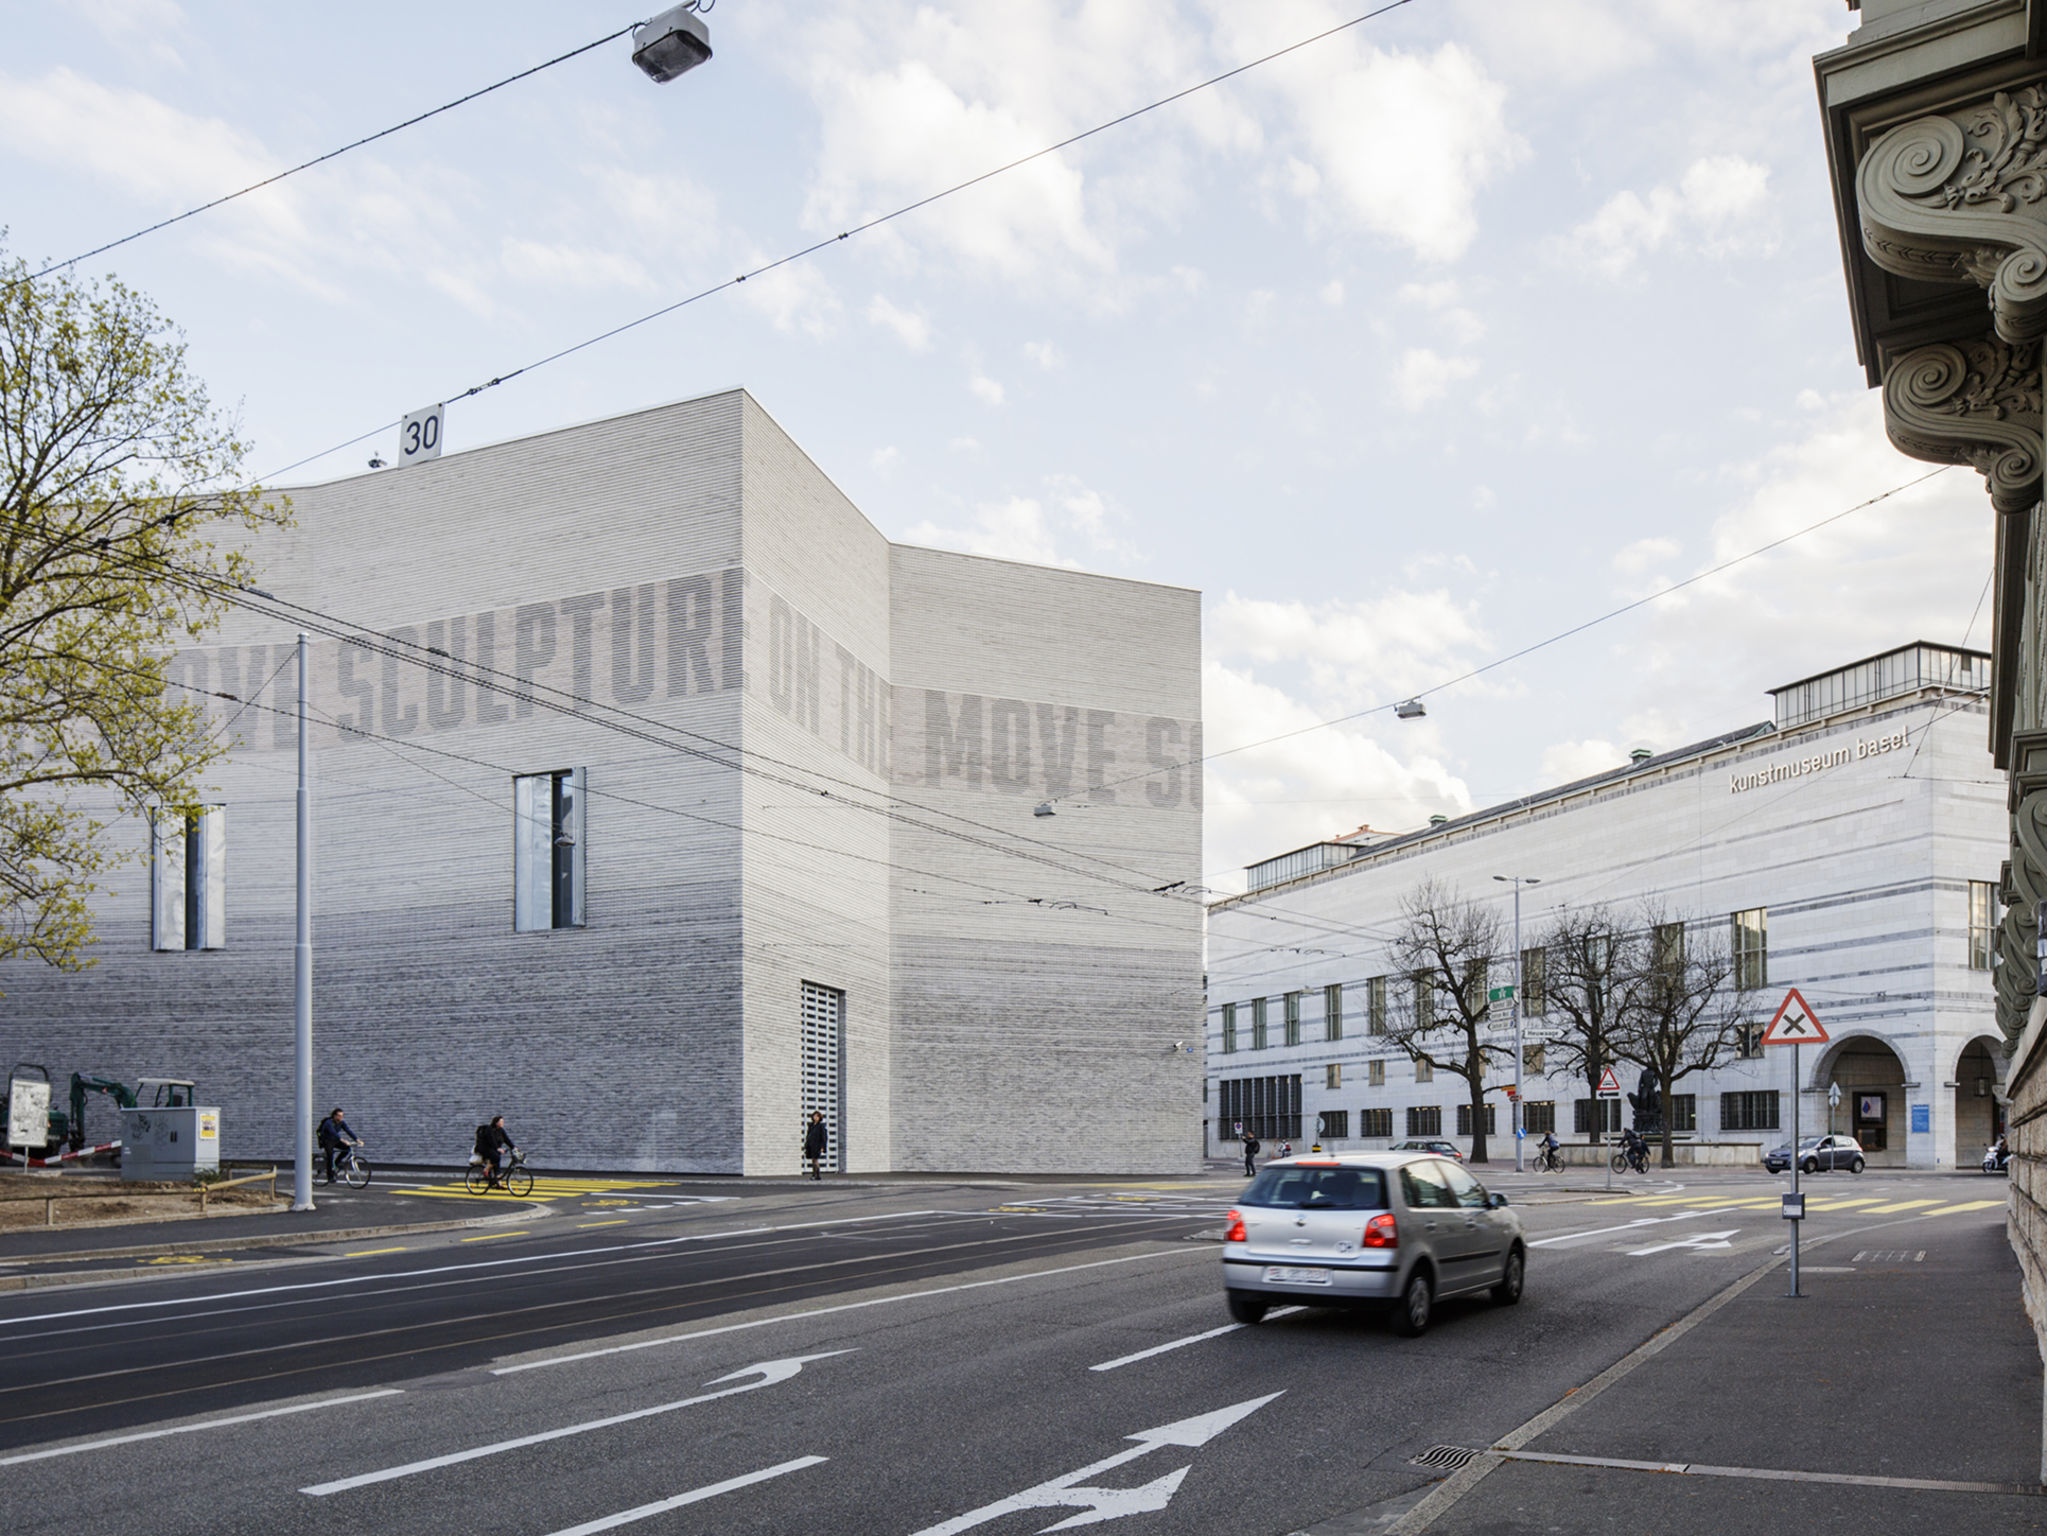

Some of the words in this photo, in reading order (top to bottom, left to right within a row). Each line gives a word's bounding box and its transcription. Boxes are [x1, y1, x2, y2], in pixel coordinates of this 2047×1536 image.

[404, 415, 438, 455] 30
[769, 594, 819, 735] ON
[925, 689, 1116, 802] MOVE
[1729, 747, 1851, 794] kunstmuseum
[1856, 725, 1910, 759] basel
